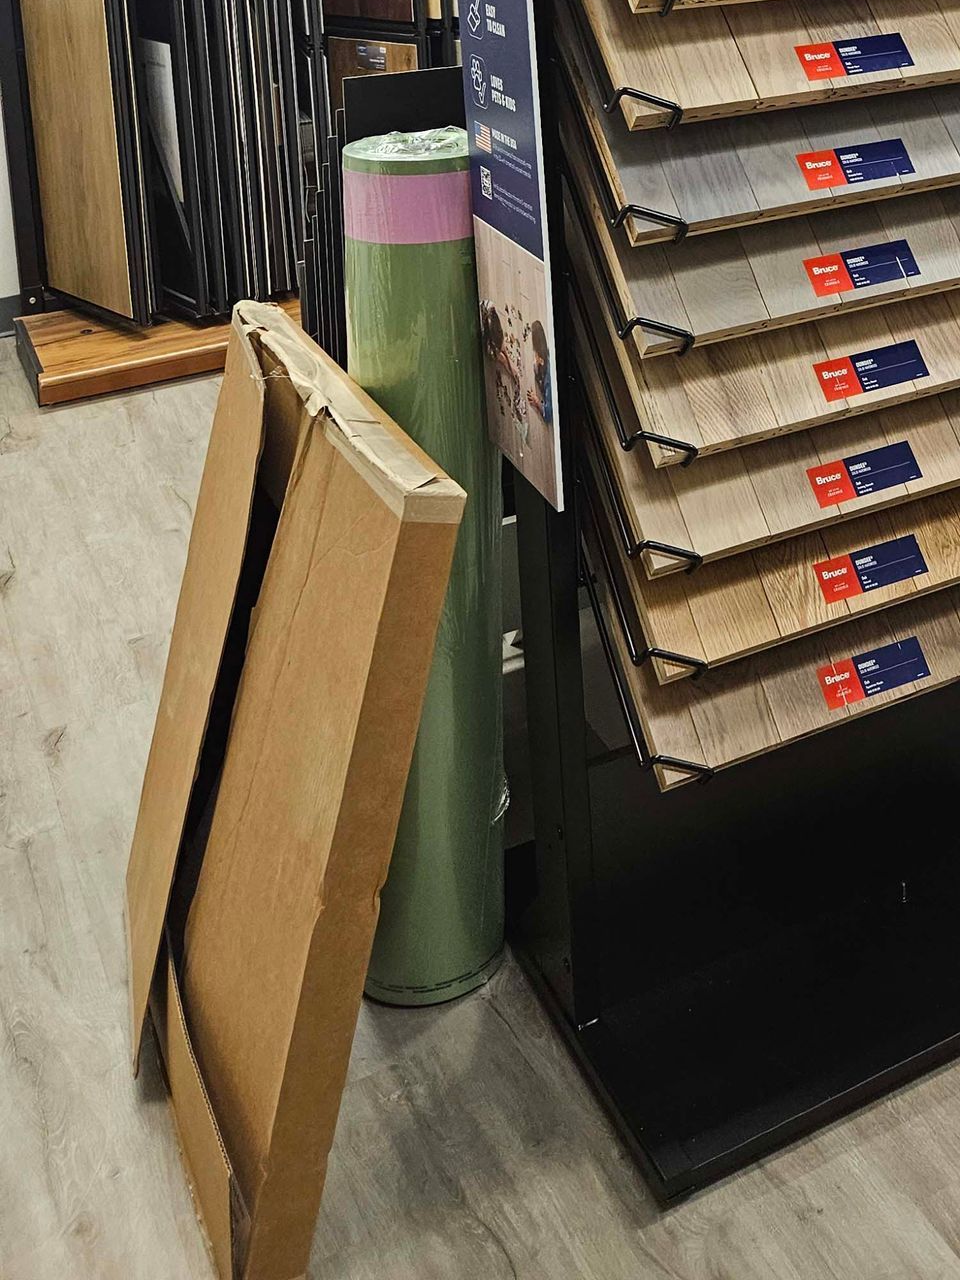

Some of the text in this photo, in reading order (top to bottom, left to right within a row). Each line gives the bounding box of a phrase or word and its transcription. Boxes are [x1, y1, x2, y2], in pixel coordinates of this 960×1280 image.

[804, 52, 830, 61] Bruce
[805, 160, 832, 170] Bruce
[812, 264, 839, 275] Bruce
[822, 368, 848, 380] Bruce
[815, 473, 842, 485] Bruce
[821, 567, 847, 580] Bruce
